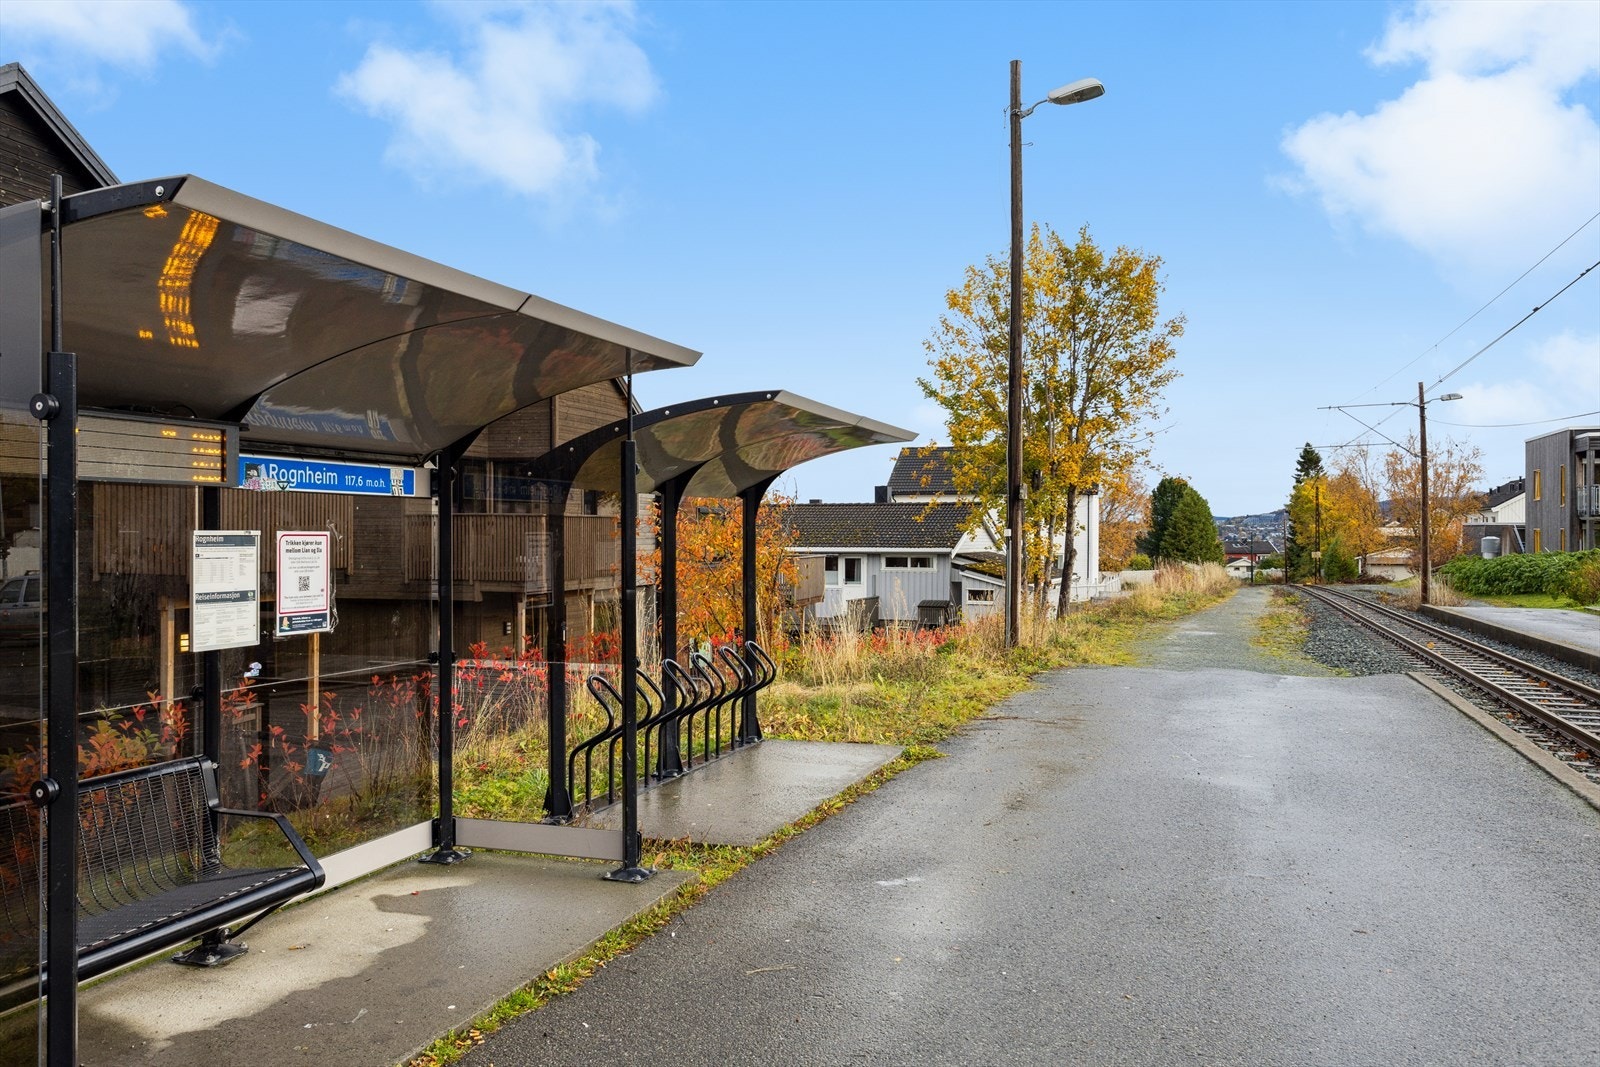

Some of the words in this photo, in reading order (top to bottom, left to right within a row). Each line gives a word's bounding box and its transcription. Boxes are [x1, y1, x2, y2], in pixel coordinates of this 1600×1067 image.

[269, 463, 338, 486] Rognheim
[345, 475, 364, 487] 117,6
[365, 478, 386, 488] m.o.h.
[195, 592, 240, 601] Reiseinformasjon
